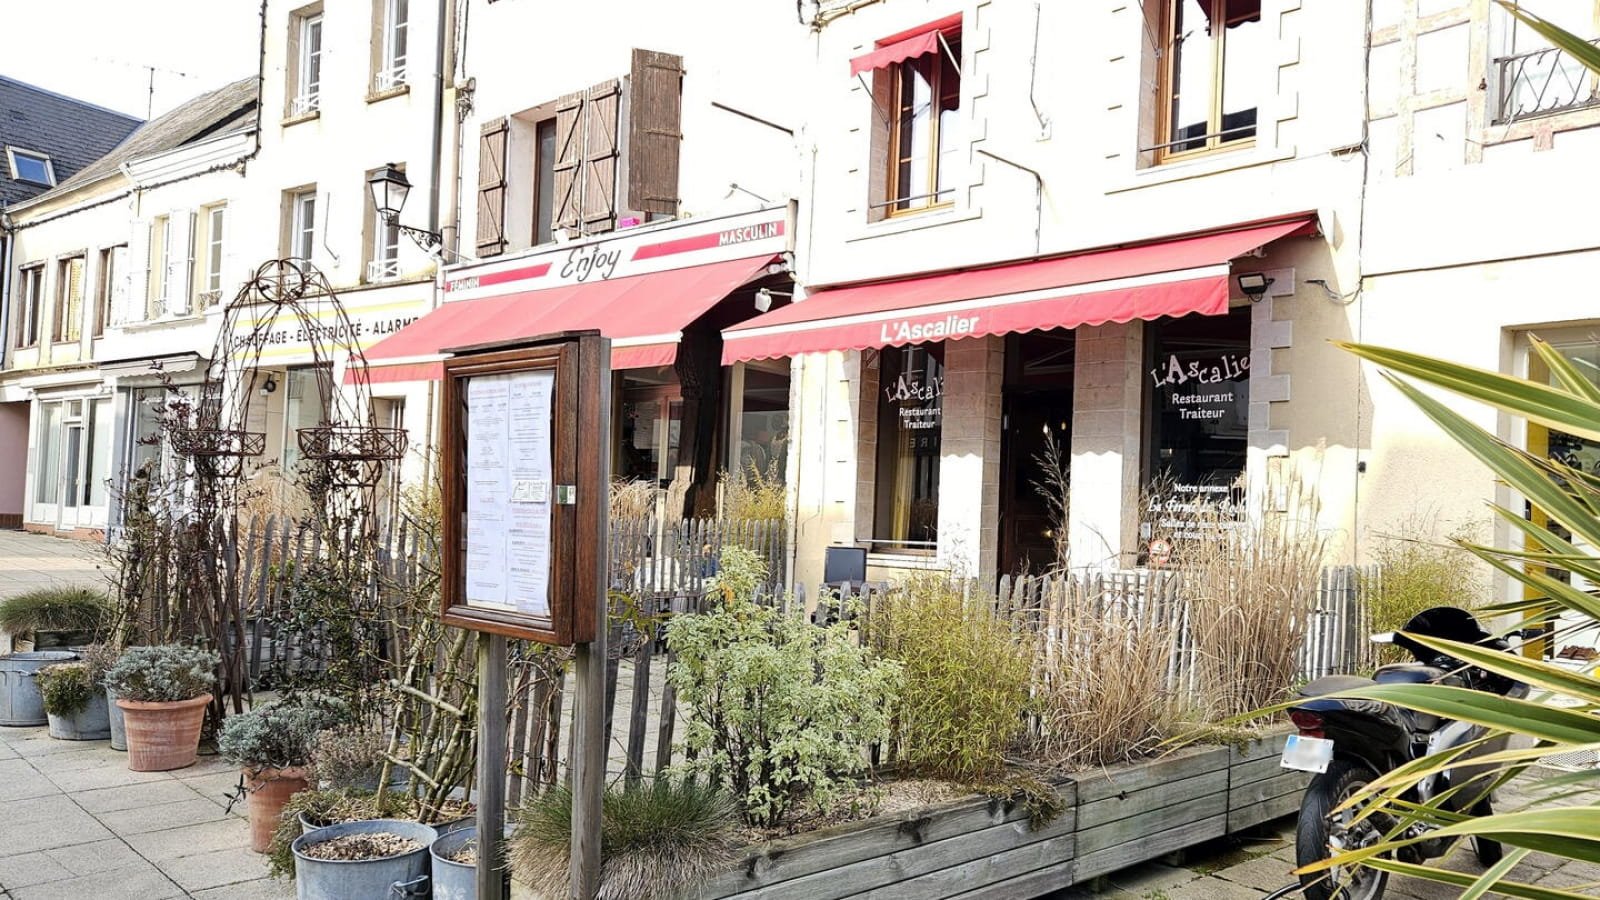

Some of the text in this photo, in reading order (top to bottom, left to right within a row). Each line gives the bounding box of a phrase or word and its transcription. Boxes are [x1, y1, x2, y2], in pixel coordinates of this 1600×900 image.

[718, 222, 777, 247] MASCULIN
[560, 243, 622, 282] Enjoy
[372, 316, 419, 336] ALARM
[880, 314, 980, 343] L'Ascalier
[1171, 391, 1234, 405] Restaurant
[899, 407, 941, 417] Restaurant
[1179, 406, 1225, 420] Traiteur
[903, 419, 936, 429] Traiteur
[1174, 483, 1198, 493] Notre
